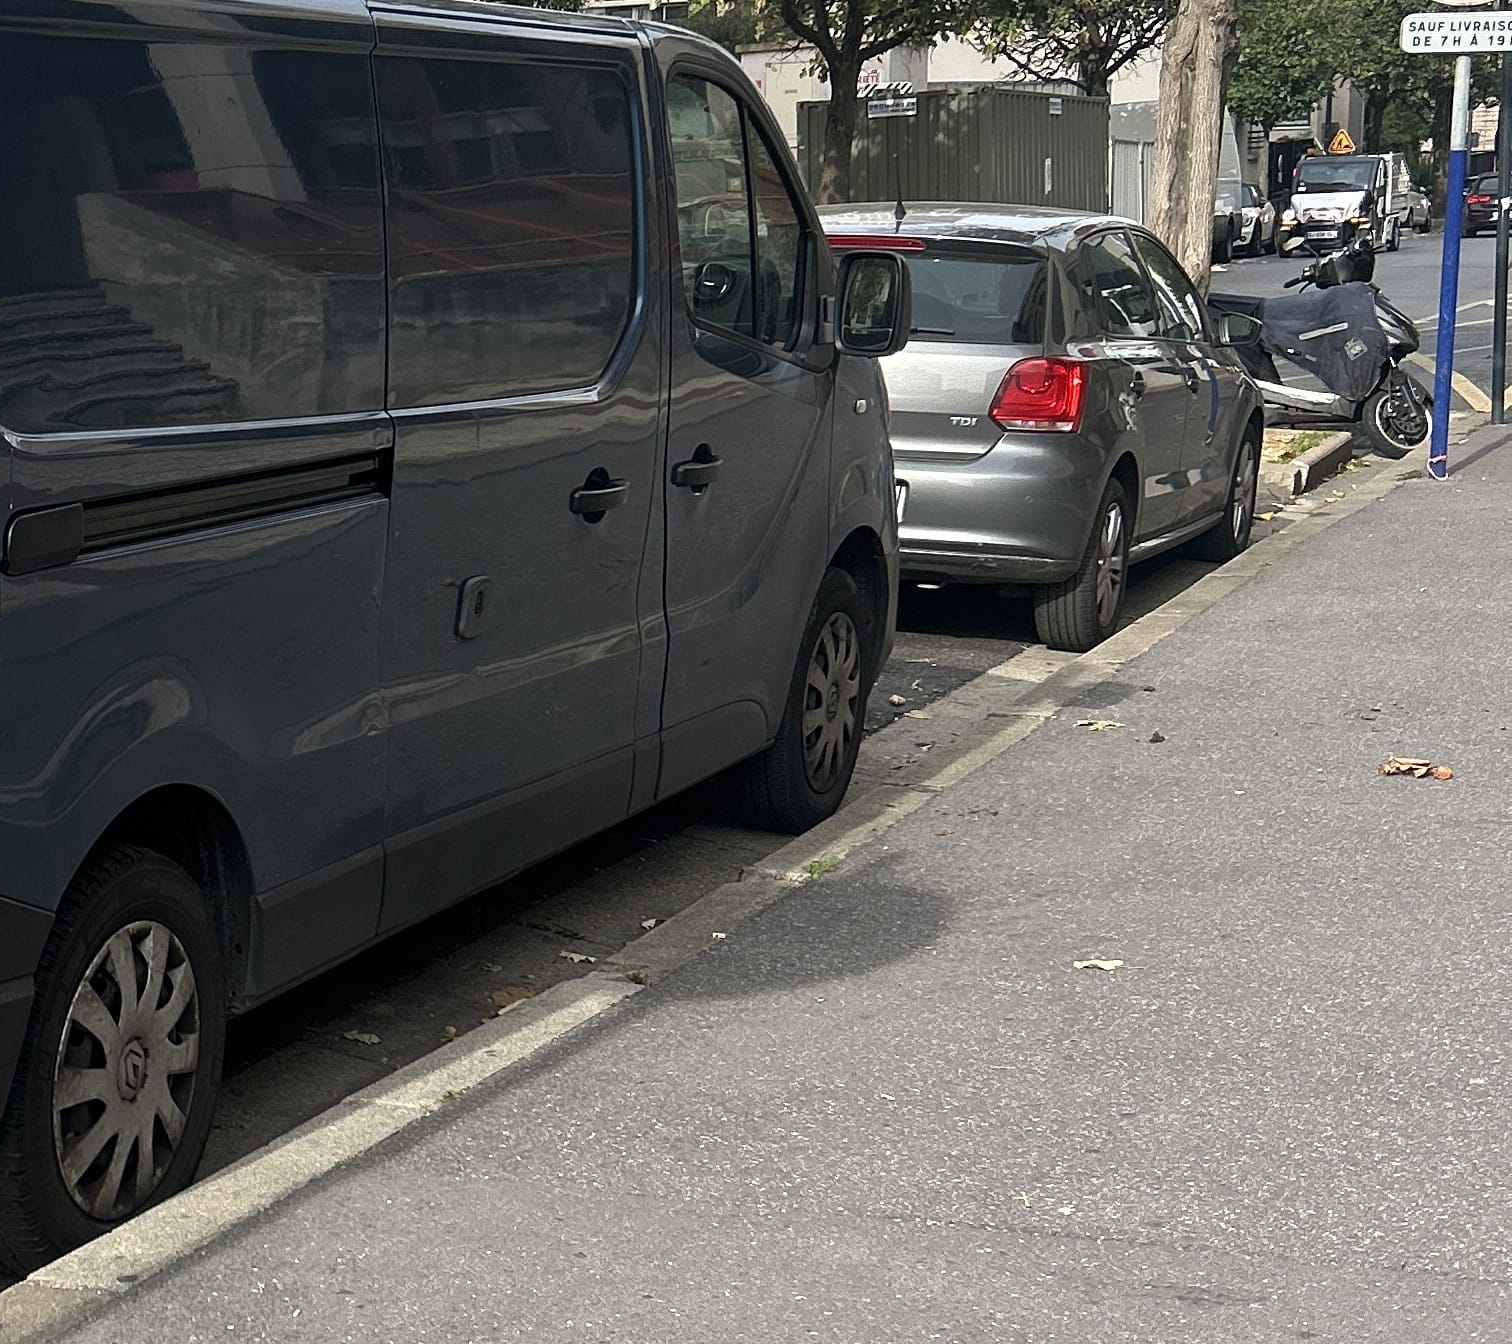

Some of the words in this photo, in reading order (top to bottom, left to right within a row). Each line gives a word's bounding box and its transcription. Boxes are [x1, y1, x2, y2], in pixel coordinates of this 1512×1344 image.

[1408, 21, 1446, 33] SAUF
[1412, 36, 1432, 47] DE
[949, 416, 978, 427] TDI
